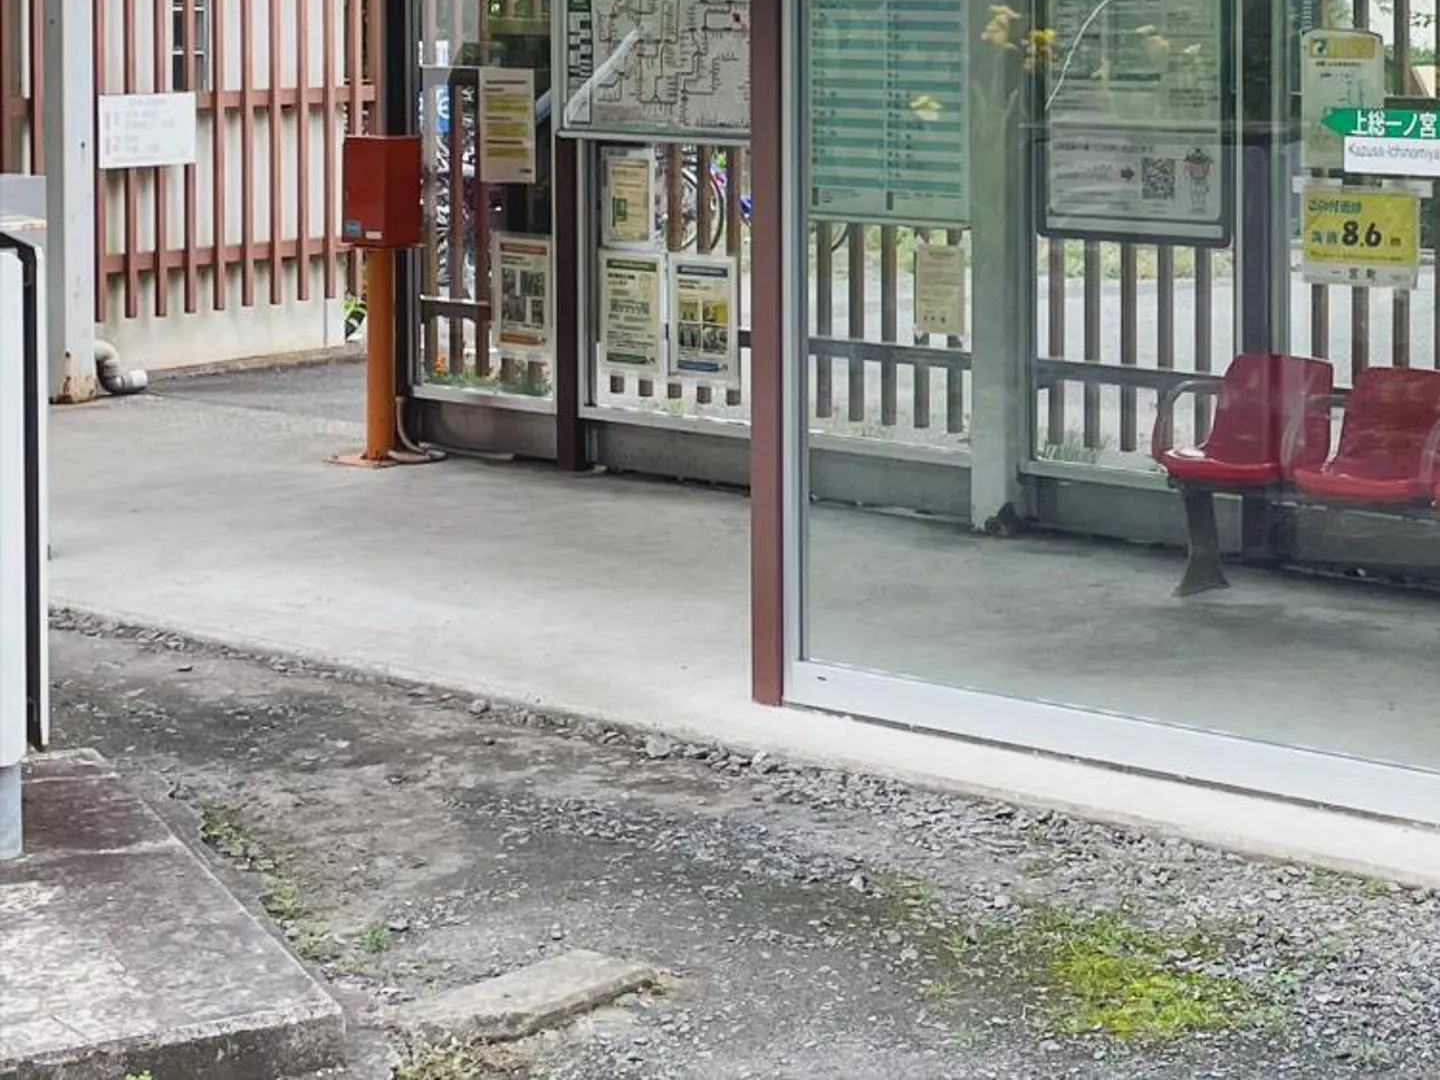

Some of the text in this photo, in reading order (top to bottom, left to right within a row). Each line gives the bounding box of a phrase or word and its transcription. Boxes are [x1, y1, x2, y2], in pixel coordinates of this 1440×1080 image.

[1350, 109, 1437, 139] 上総一ノ宮
[1342, 220, 1382, 248] 8.6
